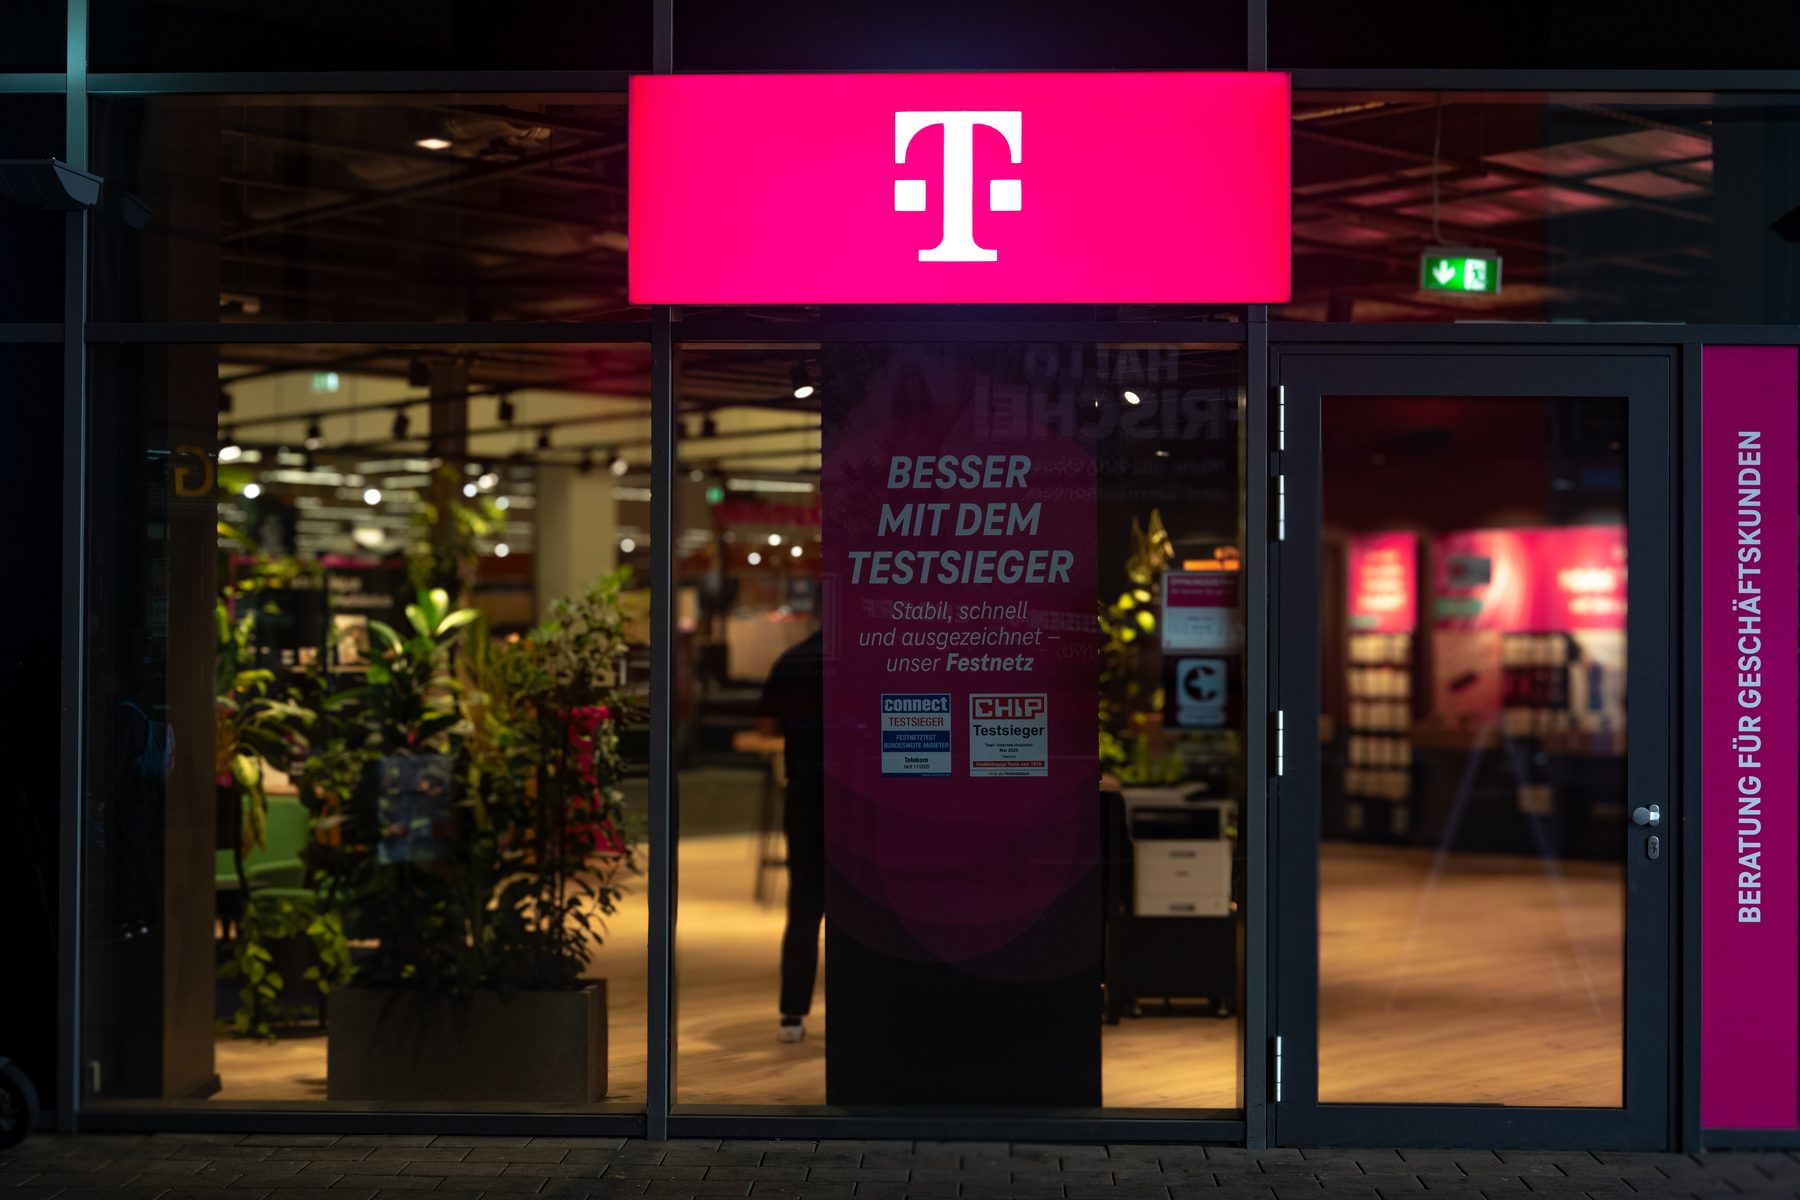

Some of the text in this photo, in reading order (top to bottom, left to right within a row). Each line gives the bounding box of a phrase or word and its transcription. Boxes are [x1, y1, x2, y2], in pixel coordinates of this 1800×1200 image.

[887, 454, 1032, 490] BESSER
[877, 502, 1042, 537] MIT DEM
[848, 549, 1074, 585] TESTSIEGER
[891, 600, 1028, 623] Stabil, schnell
[859, 627, 897, 646] und
[902, 627, 1042, 650] ausgezeichnet
[886, 657, 941, 672] unser
[945, 652, 1035, 672] Festnetz
[1732, 431, 1762, 923] BERATUNG FÜR GESCHÄFTSKUNDEN
[884, 697, 948, 711] connect
[974, 698, 1043, 718] CHIP
[888, 717, 944, 727] TESTSIEGER
[973, 724, 1045, 739] Testsieger
